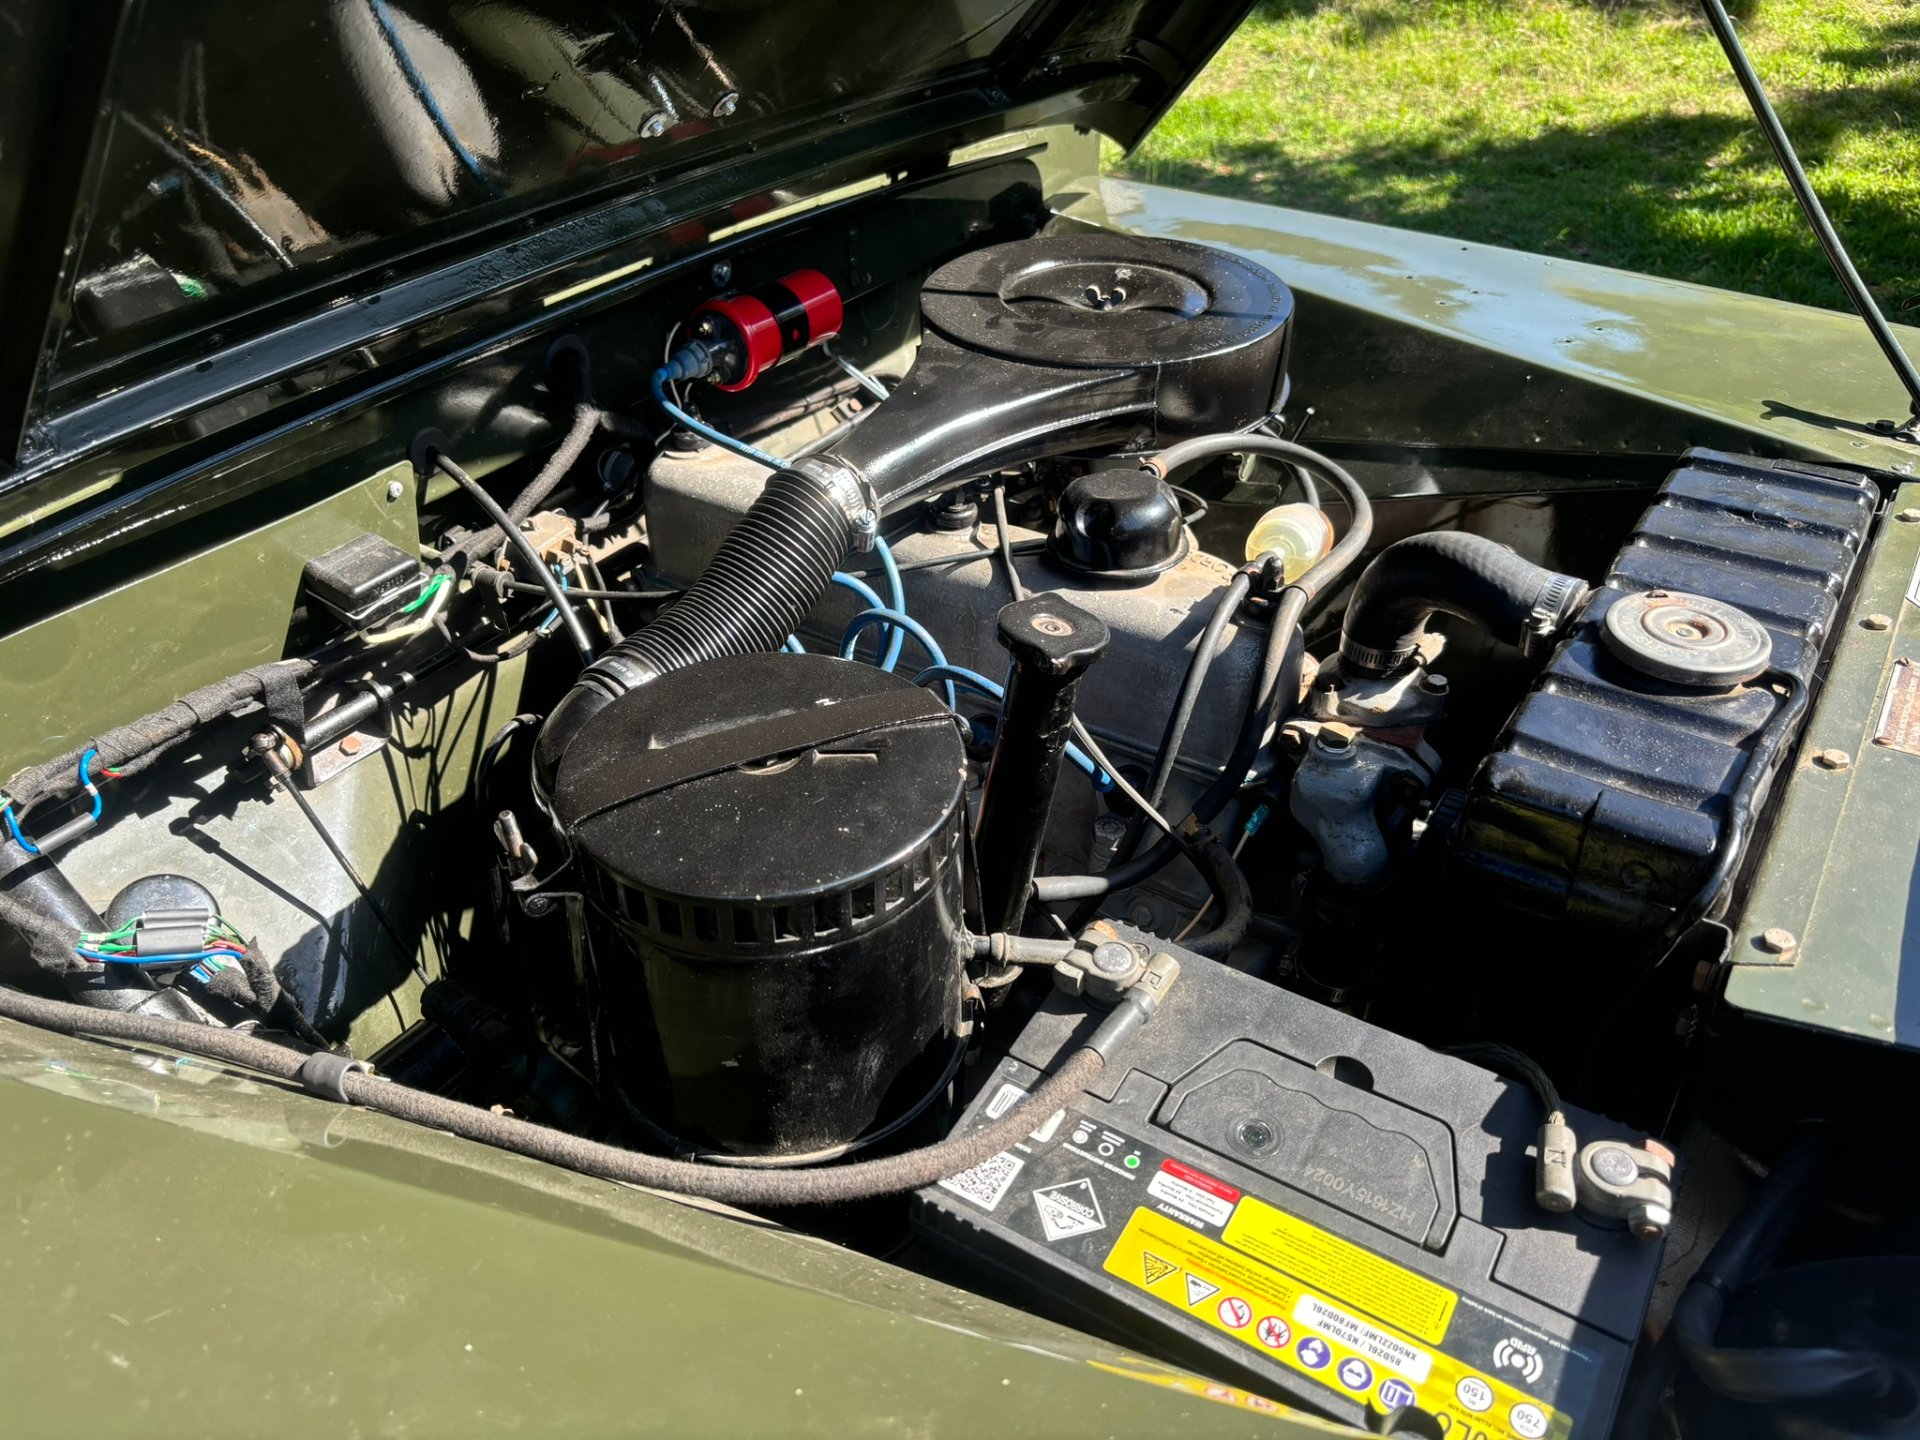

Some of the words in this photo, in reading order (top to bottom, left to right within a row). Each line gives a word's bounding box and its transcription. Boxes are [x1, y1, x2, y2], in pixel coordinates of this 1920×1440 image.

[1103, 1162, 1135, 1180] INDICATOR
[1048, 1188, 1095, 1219] CORROSIVE
[1156, 1201, 1205, 1229] WARRANTY
[1310, 1302, 1359, 1331] MF80D26L
[1316, 1318, 1359, 1344] NS70LMF
[1507, 1335, 1537, 1356] RFID
[1461, 1382, 1487, 1401] 150
[1515, 1409, 1542, 1428] 750
